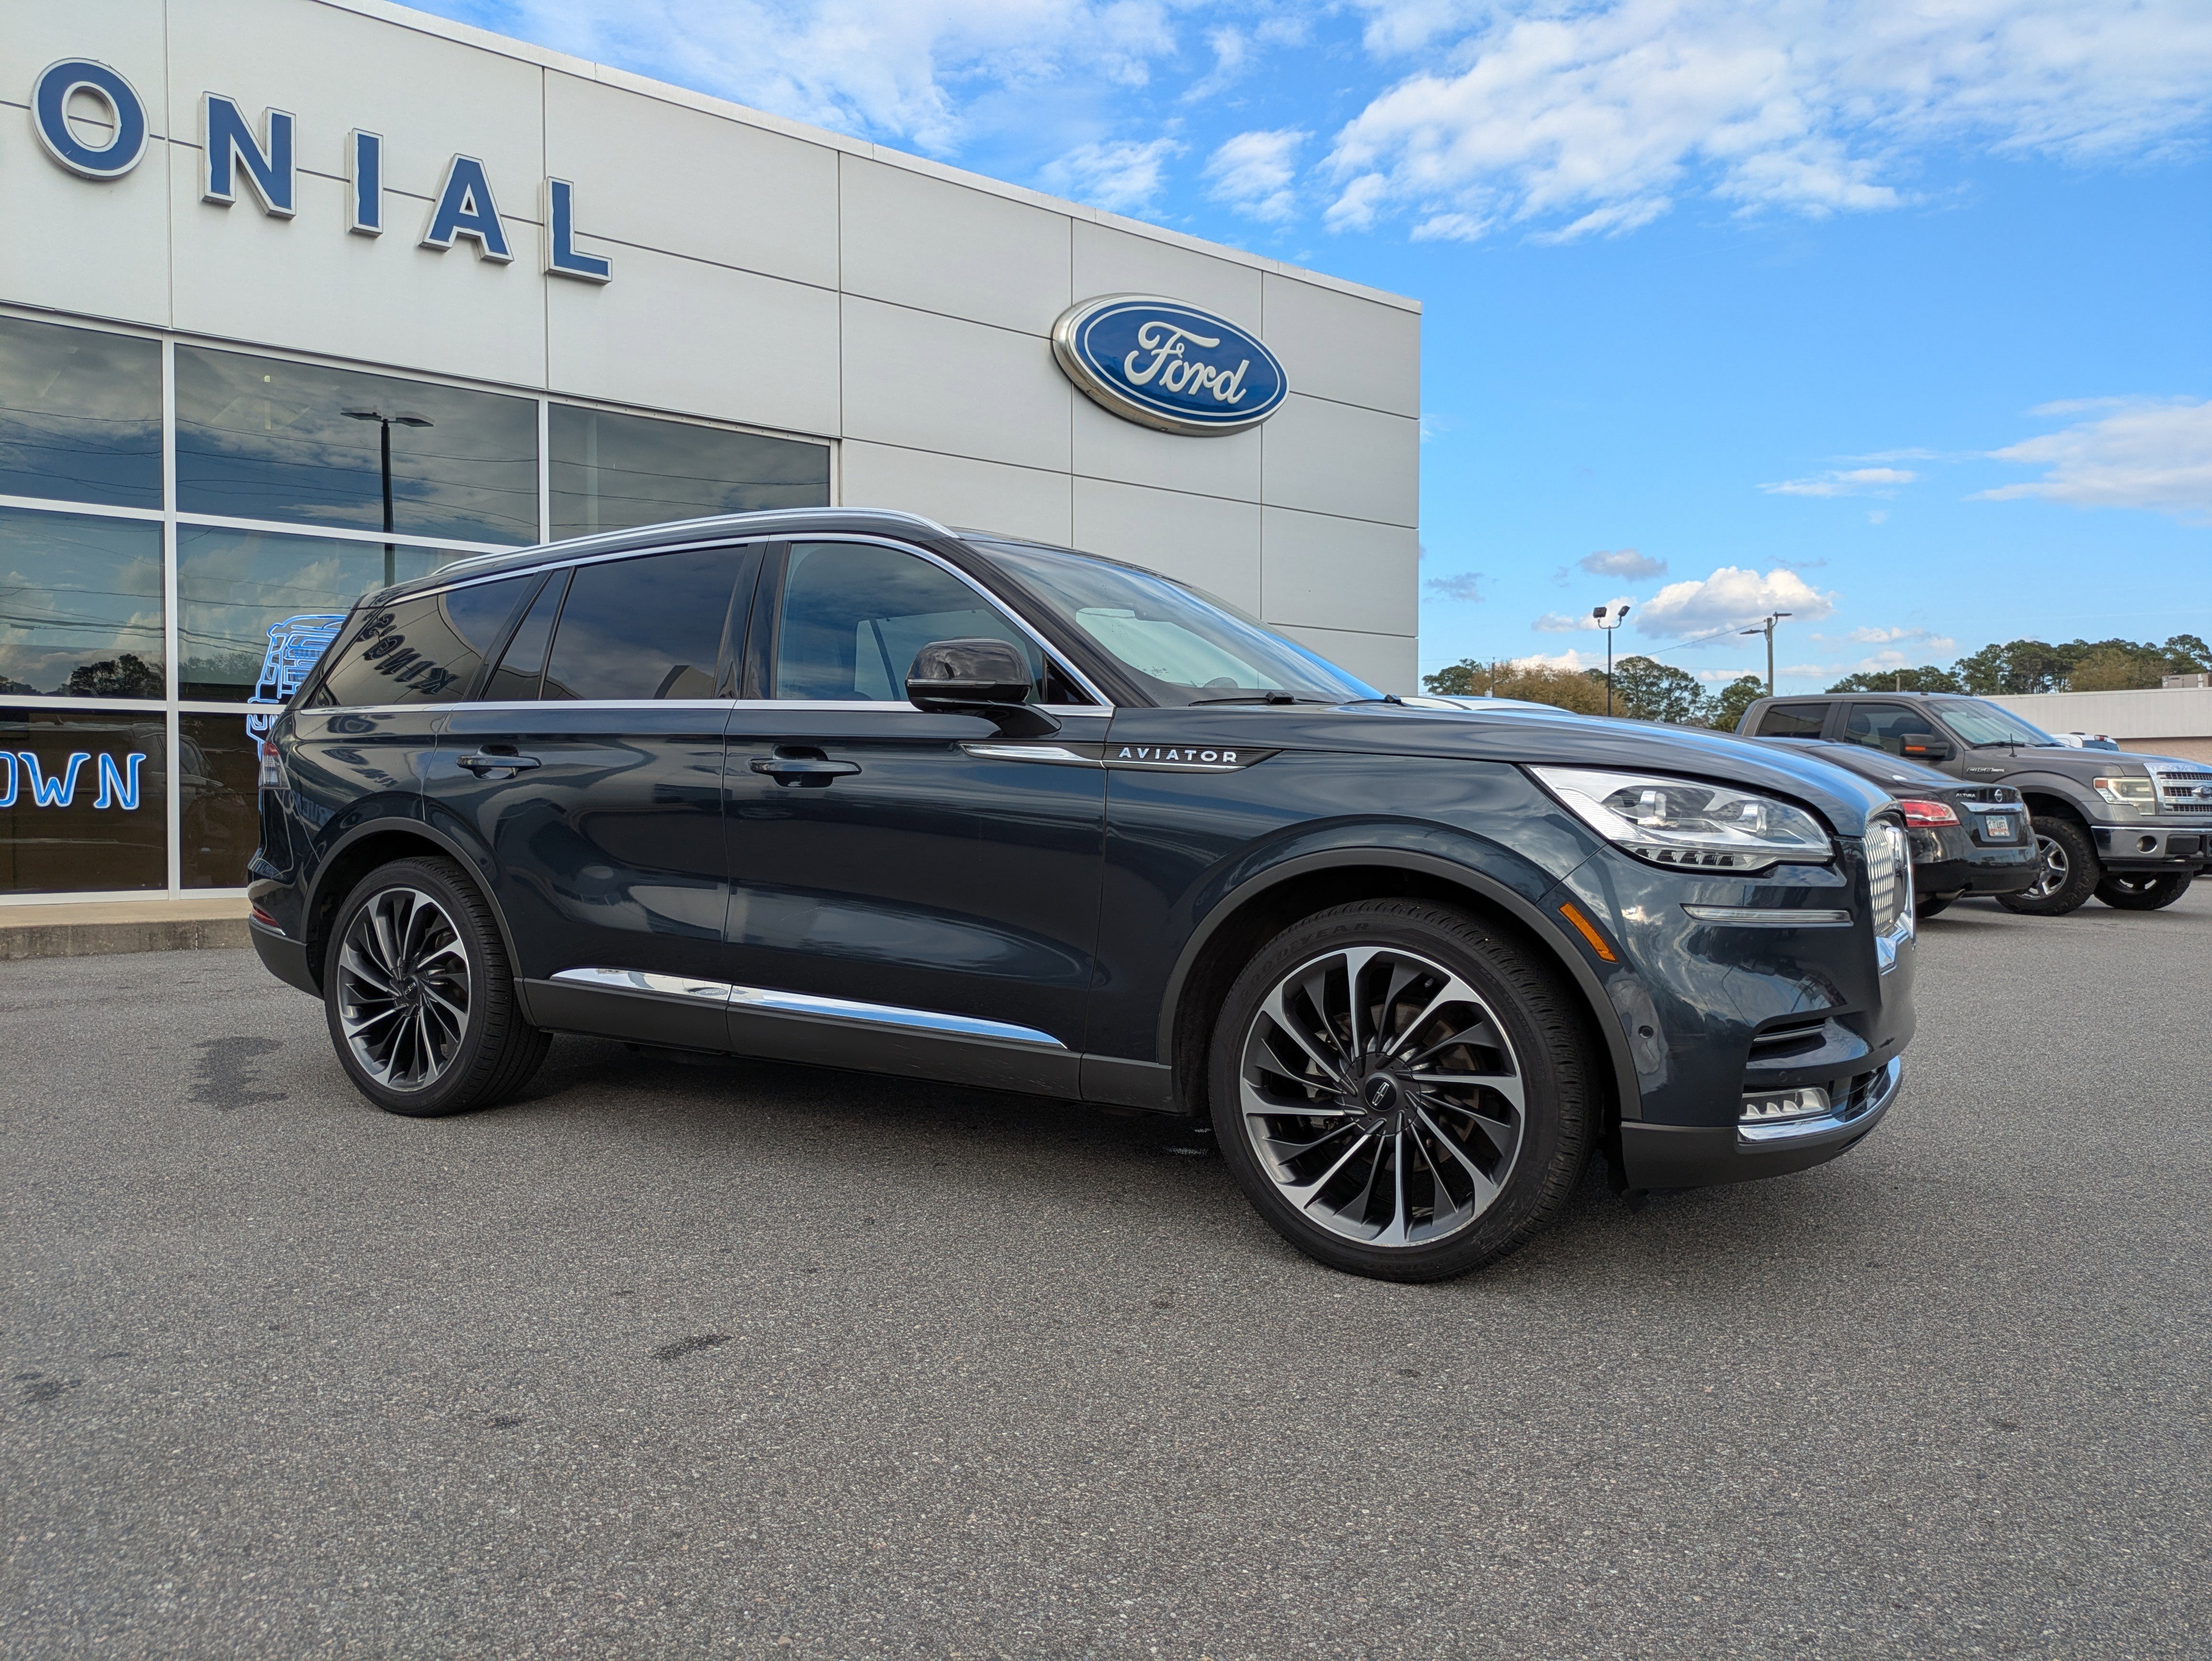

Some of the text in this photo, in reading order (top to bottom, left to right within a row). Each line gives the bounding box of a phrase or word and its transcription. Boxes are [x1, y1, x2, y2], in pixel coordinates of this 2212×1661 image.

[31, 57, 613, 286] ONIAL
[1124, 321, 1250, 405] Ford
[1118, 747, 1237, 763] AVIATOR
